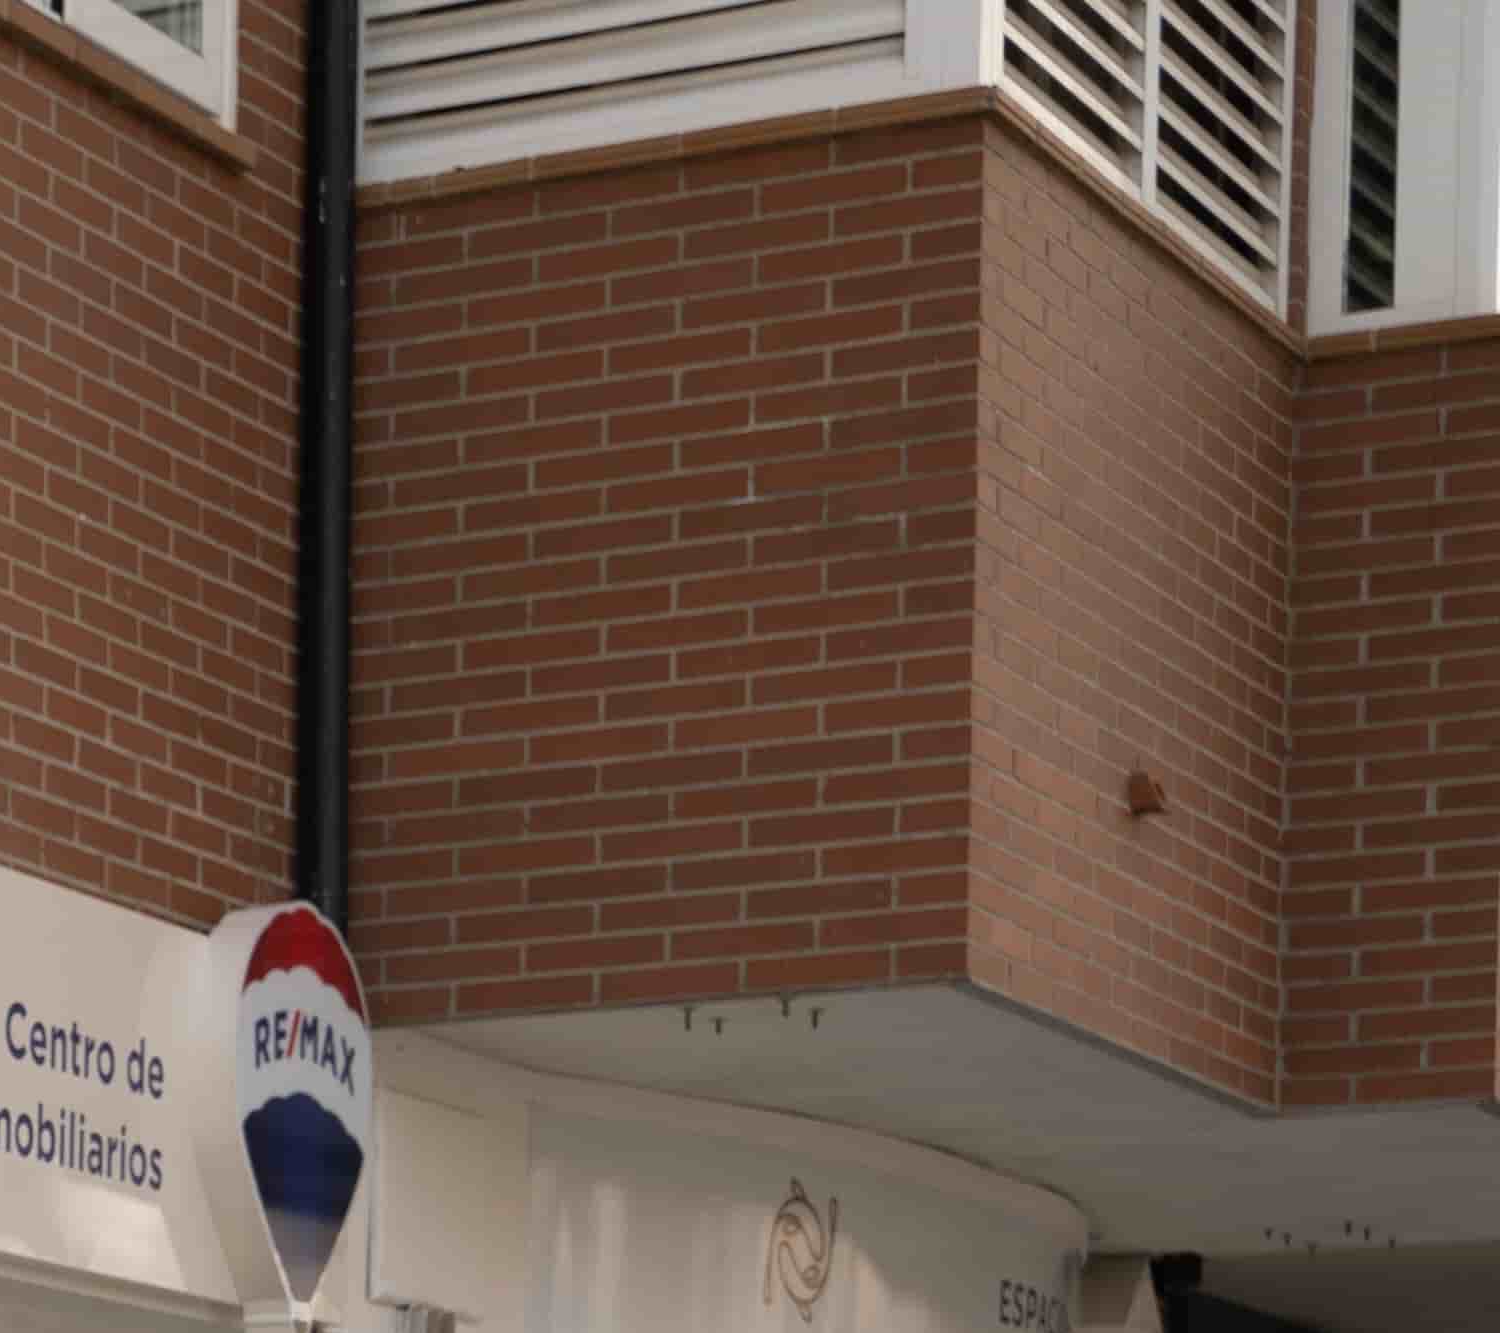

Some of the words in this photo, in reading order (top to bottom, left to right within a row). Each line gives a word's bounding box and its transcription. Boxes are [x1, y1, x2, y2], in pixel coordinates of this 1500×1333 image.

[5, 1000, 116, 1087] Centro
[126, 1036, 165, 1100] de
[253, 1009, 357, 1097] RE/MAX
